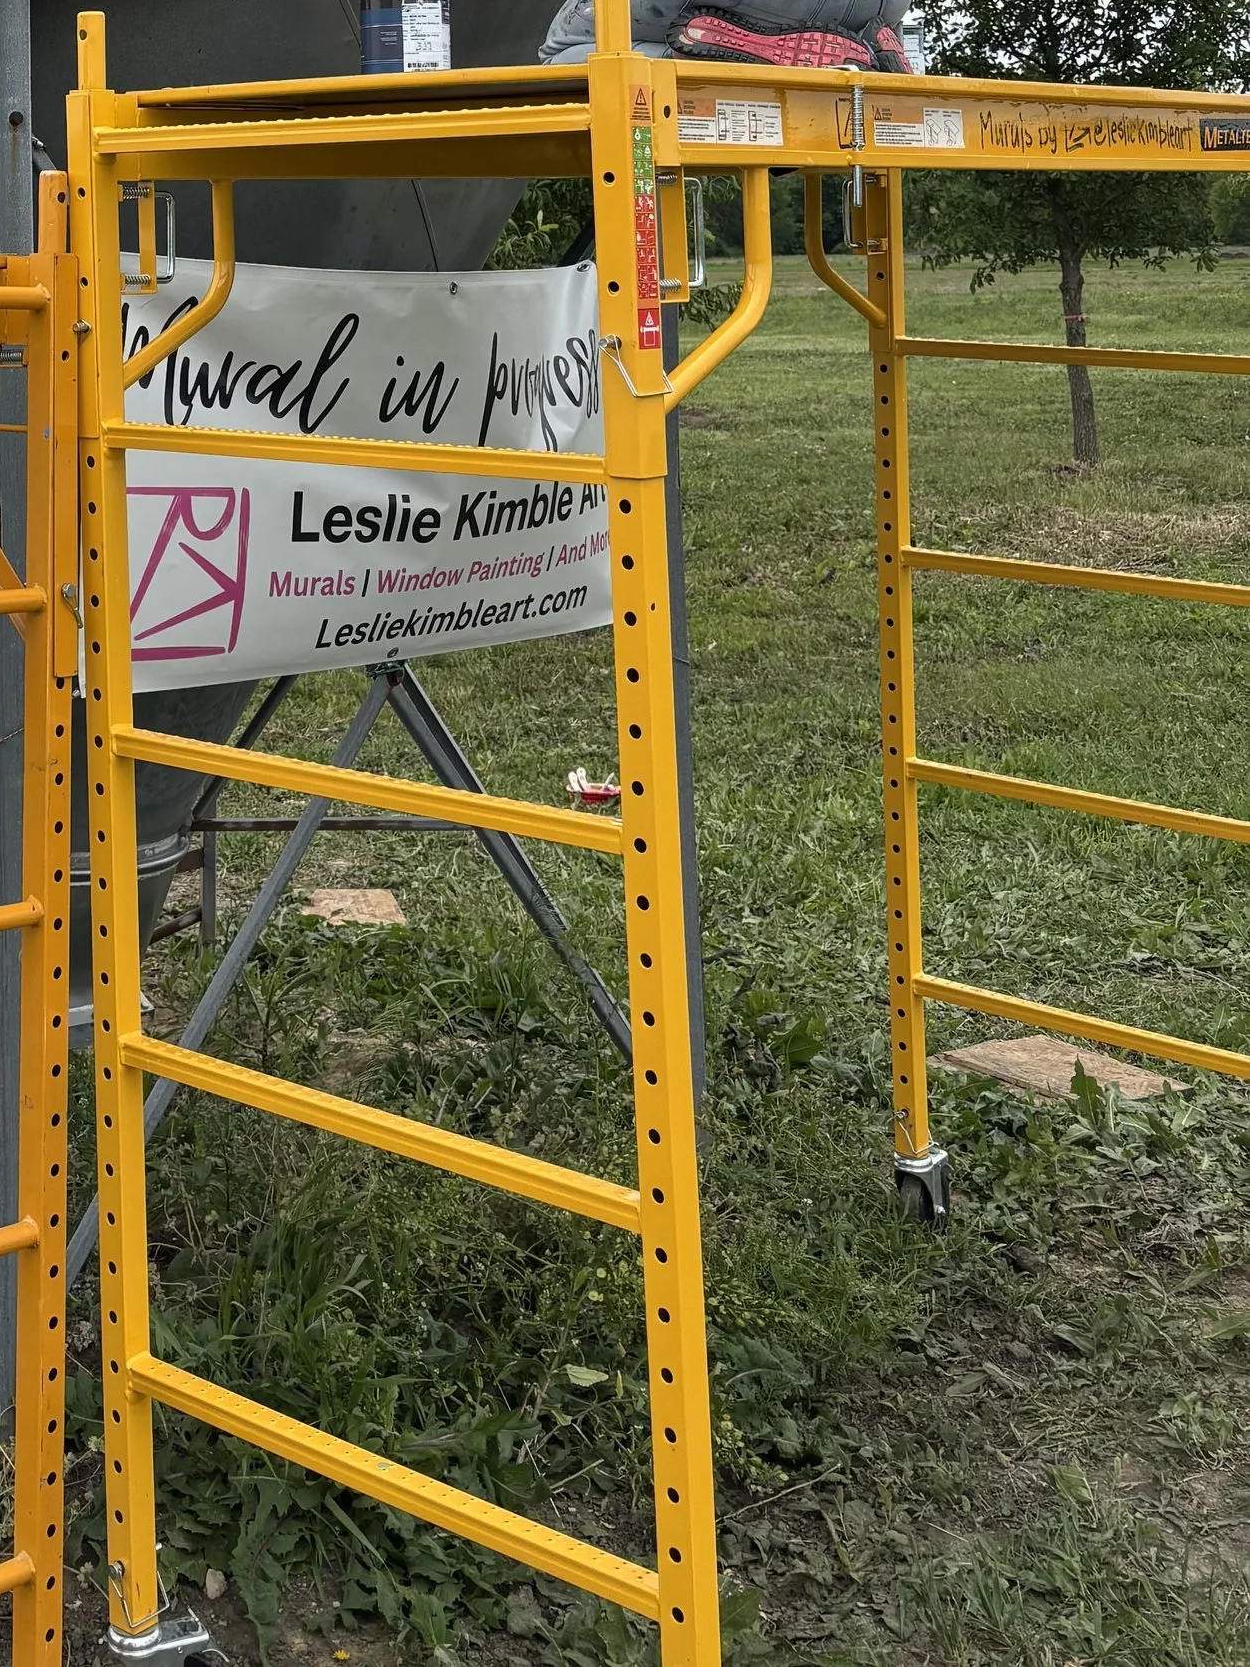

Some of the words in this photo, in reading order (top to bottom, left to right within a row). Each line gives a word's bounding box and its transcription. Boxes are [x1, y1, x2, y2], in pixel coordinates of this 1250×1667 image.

[122, 296, 359, 435] Mural
[378, 356, 459, 435] in
[477, 328, 600, 453] progress
[291, 491, 441, 544] Leslie
[452, 482, 572, 542] Kimble
[269, 567, 355, 598] Murals
[376, 560, 461, 595] Window
[466, 550, 544, 584] Painting
[555, 535, 587, 567] And
[314, 582, 589, 650] Lesliekimbleart.com
